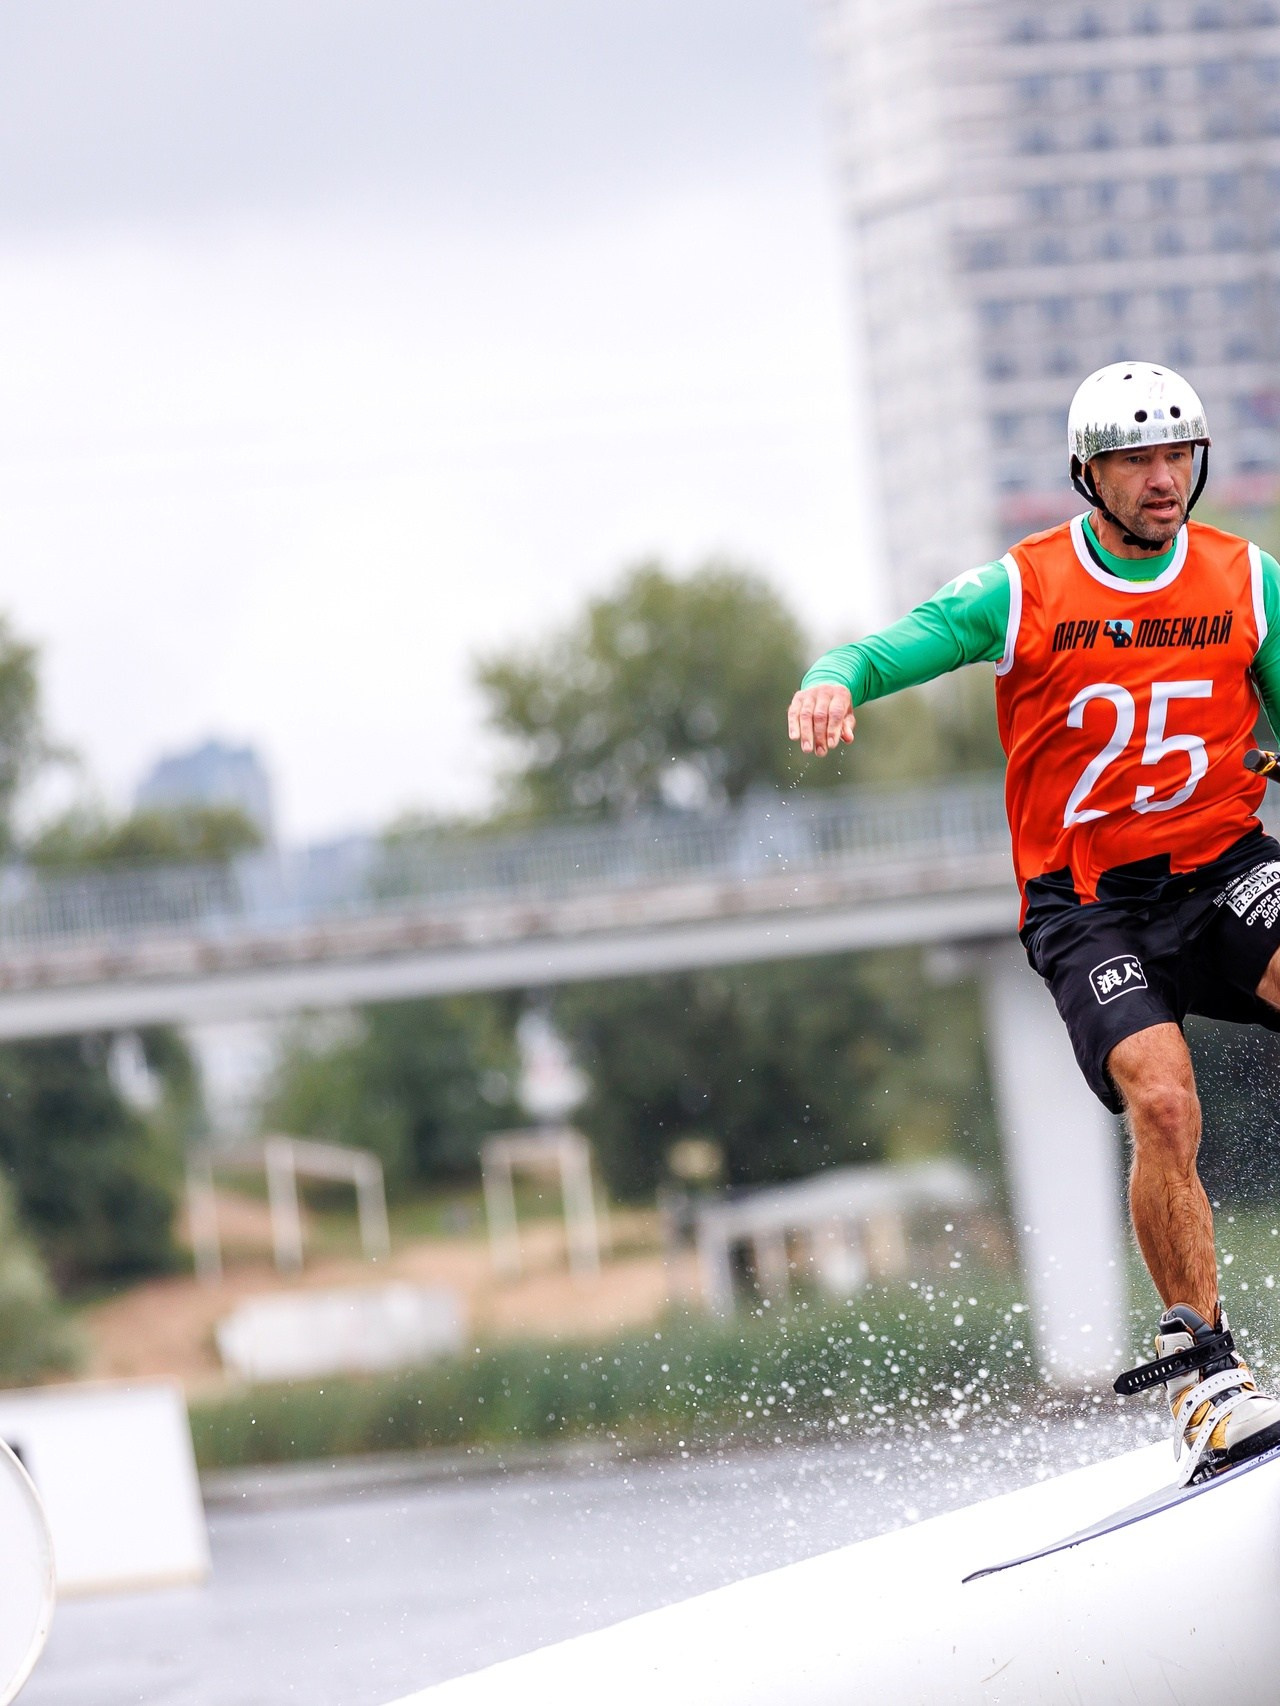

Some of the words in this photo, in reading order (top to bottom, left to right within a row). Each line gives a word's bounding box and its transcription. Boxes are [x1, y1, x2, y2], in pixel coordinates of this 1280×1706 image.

[1052, 620, 1100, 652] ПАРИ
[1135, 610, 1233, 650] ПОБЕЖДАЙ
[1063, 680, 1213, 828] 25
[1246, 894, 1273, 926] CROPP
